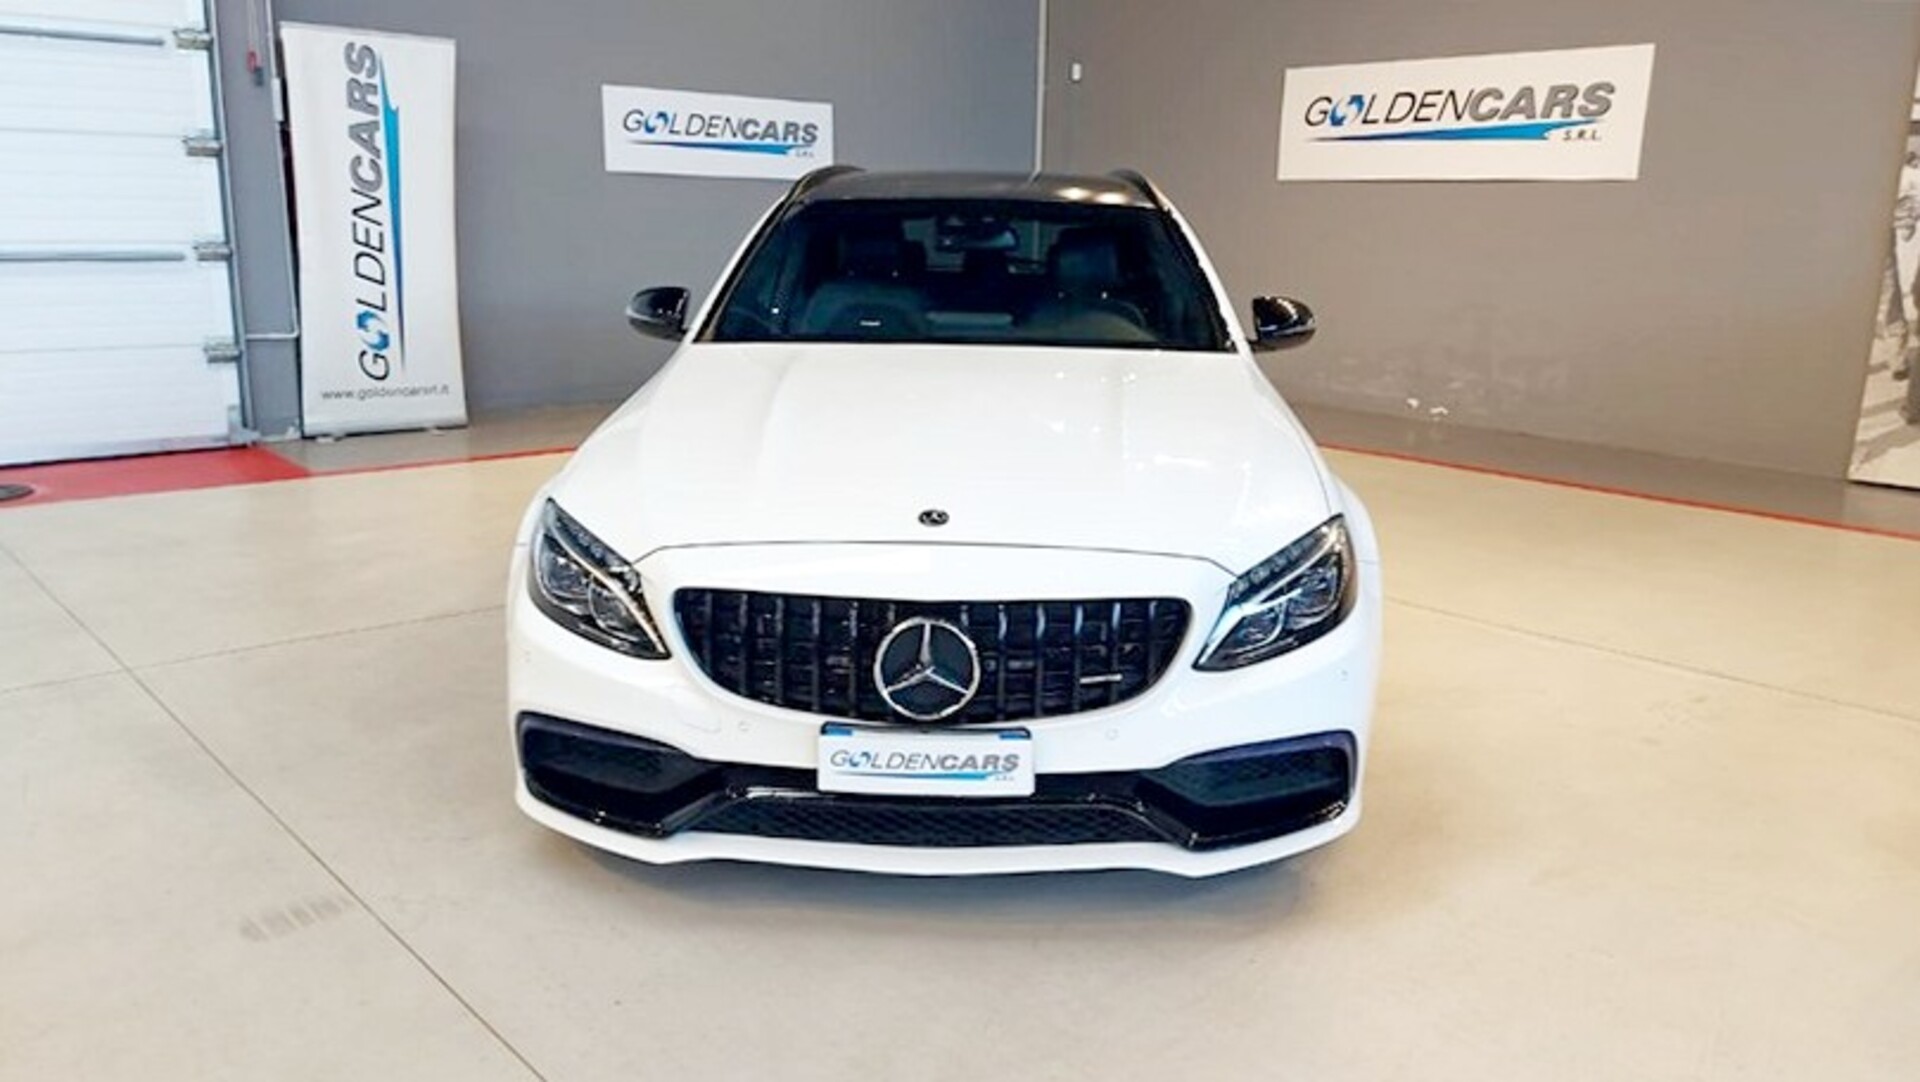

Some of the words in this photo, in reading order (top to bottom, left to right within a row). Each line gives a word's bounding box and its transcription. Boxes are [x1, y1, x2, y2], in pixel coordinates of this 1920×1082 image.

[1304, 82, 1616, 127] GOLDENCARS
[622, 109, 819, 144] GOLDENCARS
[344, 41, 390, 381] GOLDENCARS
[829, 750, 1020, 772] GOLDENCARS
